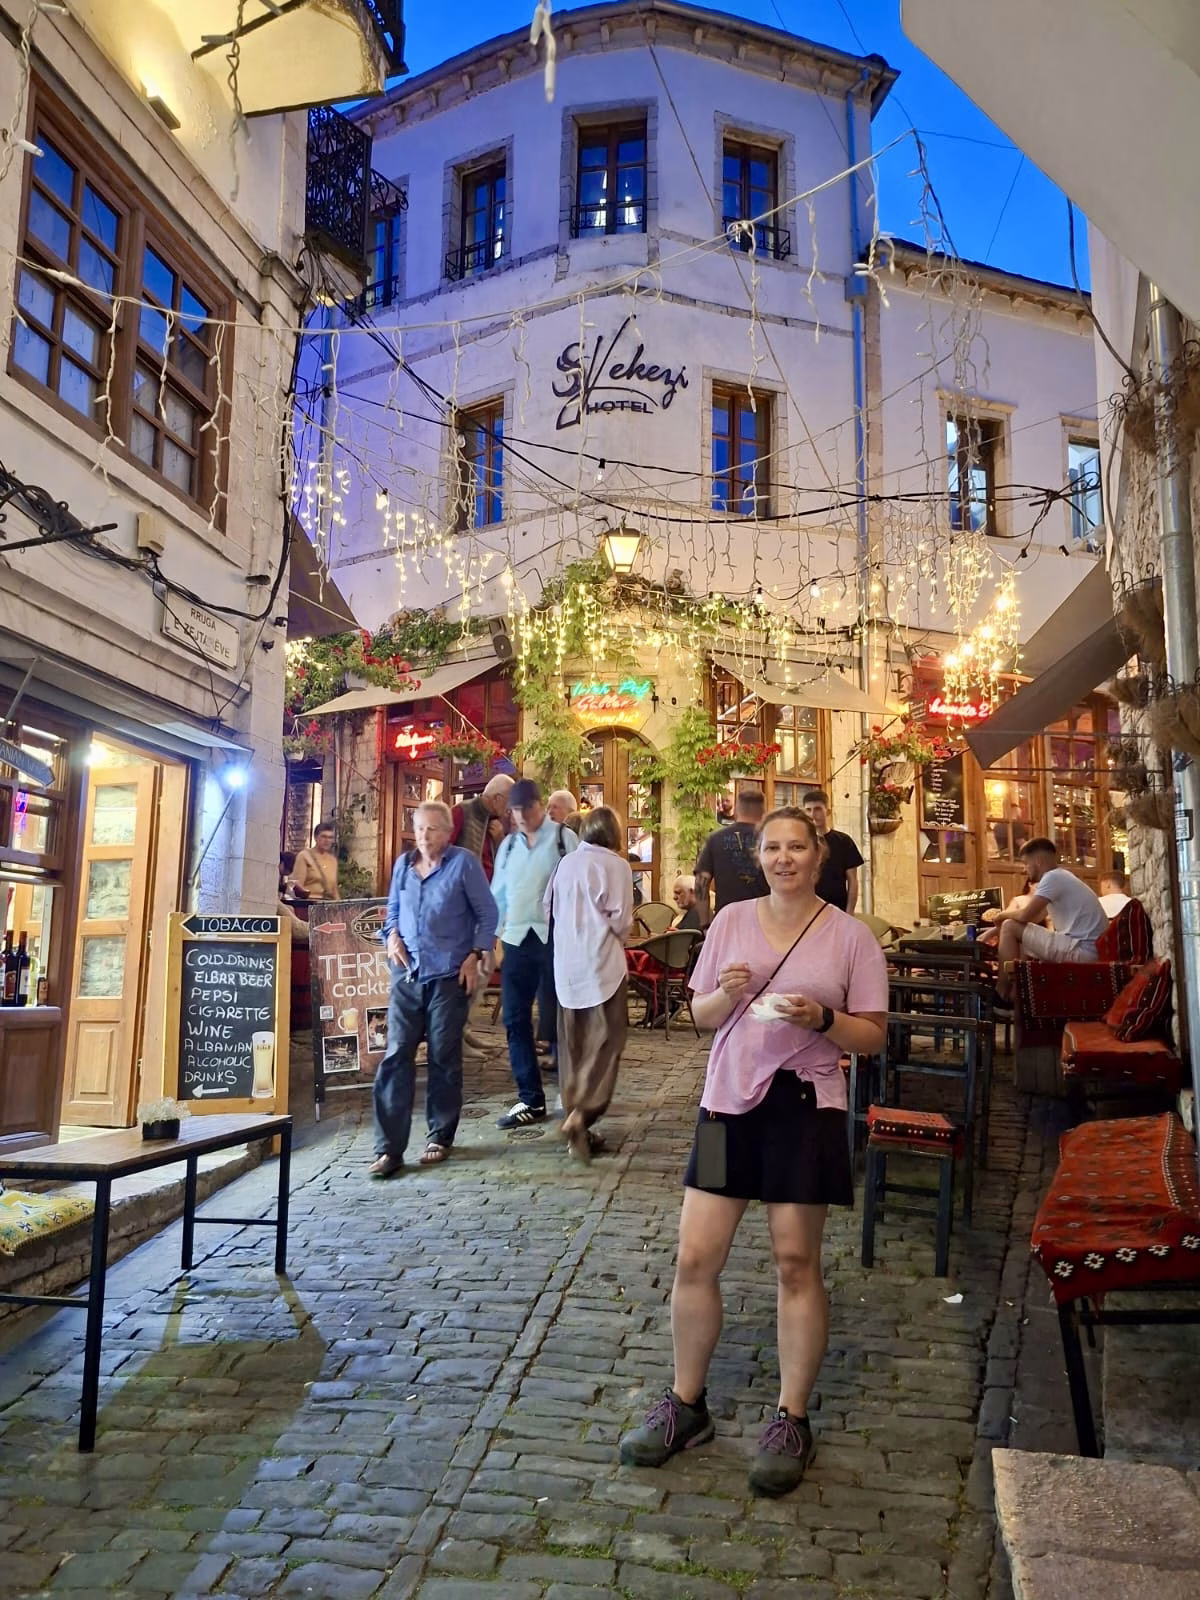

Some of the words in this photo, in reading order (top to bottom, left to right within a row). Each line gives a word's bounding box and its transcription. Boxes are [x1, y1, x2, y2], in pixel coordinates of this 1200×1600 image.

[586, 400, 653, 415] HOTEL
[174, 618, 180, 631] E
[190, 608, 216, 632] RRUGA
[979, 703, 989, 718] 2
[979, 890, 986, 899] 2
[198, 917, 272, 933] TOBACCO
[186, 949, 223, 967] COLD
[224, 956, 274, 972] DRINKS
[194, 970, 235, 985] ELBAR
[238, 972, 273, 988] BEER
[188, 1004, 271, 1021] CIGARETTE
[187, 1020, 234, 1039] WINE
[184, 1039, 252, 1053] ALBANIAN
[187, 1055, 251, 1069] ALCOHOLIC
[185, 1070, 238, 1084] DRINKS
